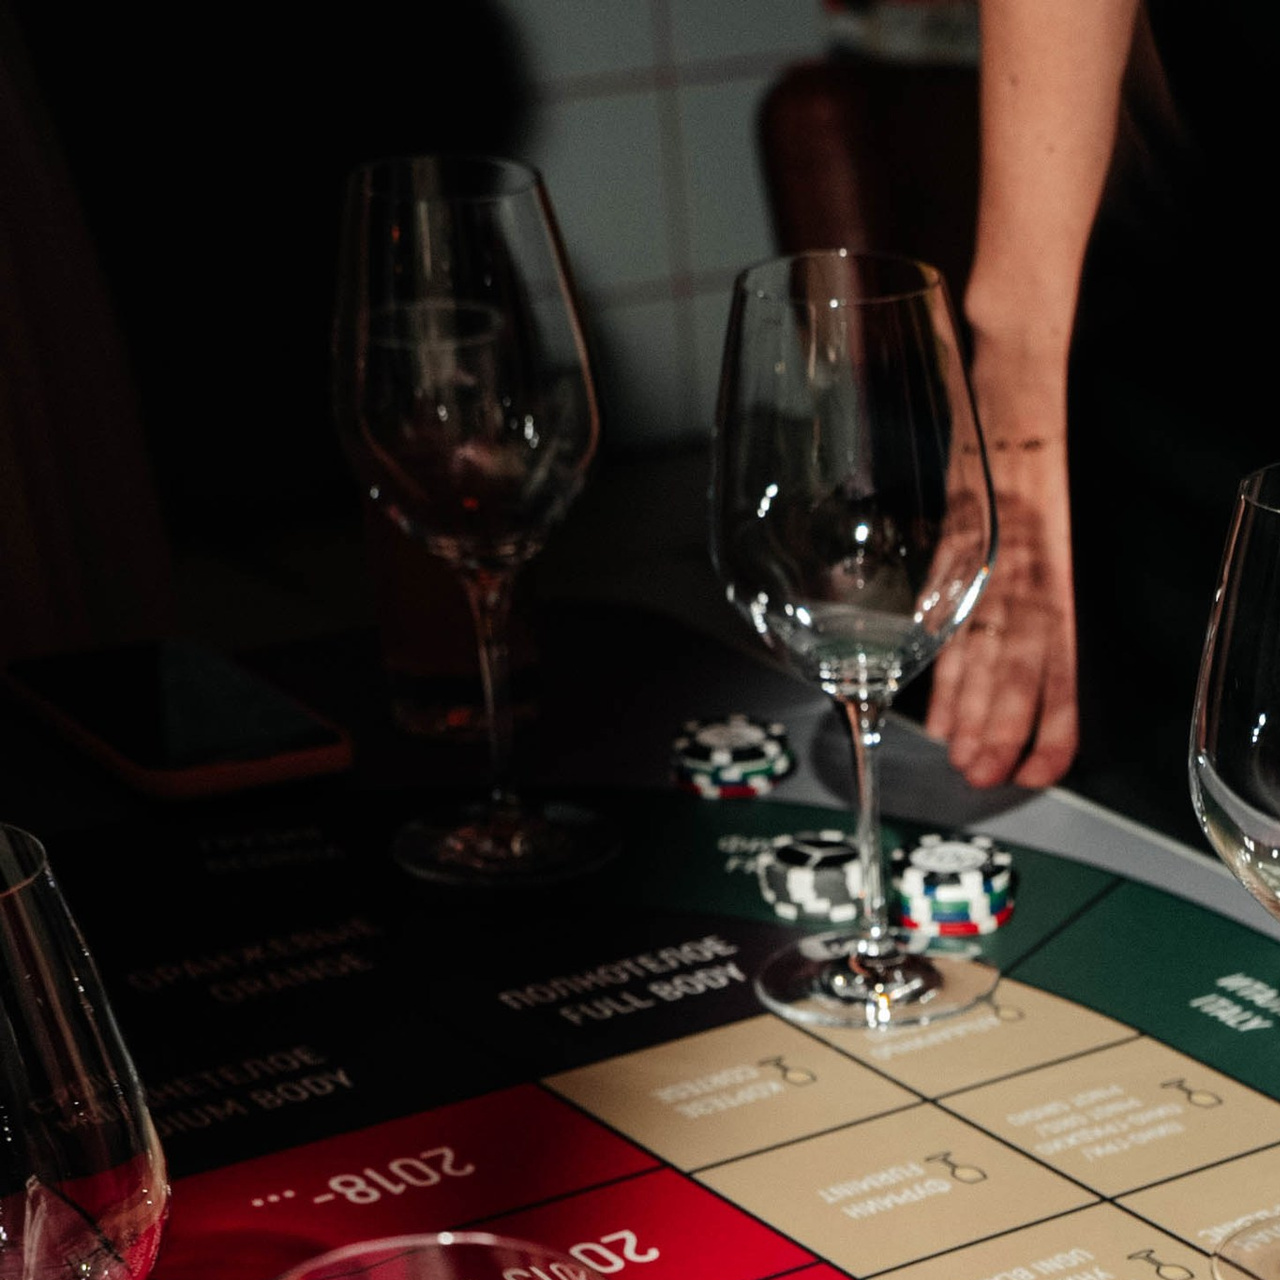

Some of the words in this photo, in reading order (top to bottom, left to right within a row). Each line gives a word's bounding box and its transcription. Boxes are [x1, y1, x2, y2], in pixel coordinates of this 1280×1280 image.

[559, 990, 656, 1026] FULL
[647, 962, 746, 1001] BODY
[1189, 993, 1274, 1032] ITALY
[249, 1066, 354, 1111] BODY
[1035, 1247, 1096, 1277] UGNI
